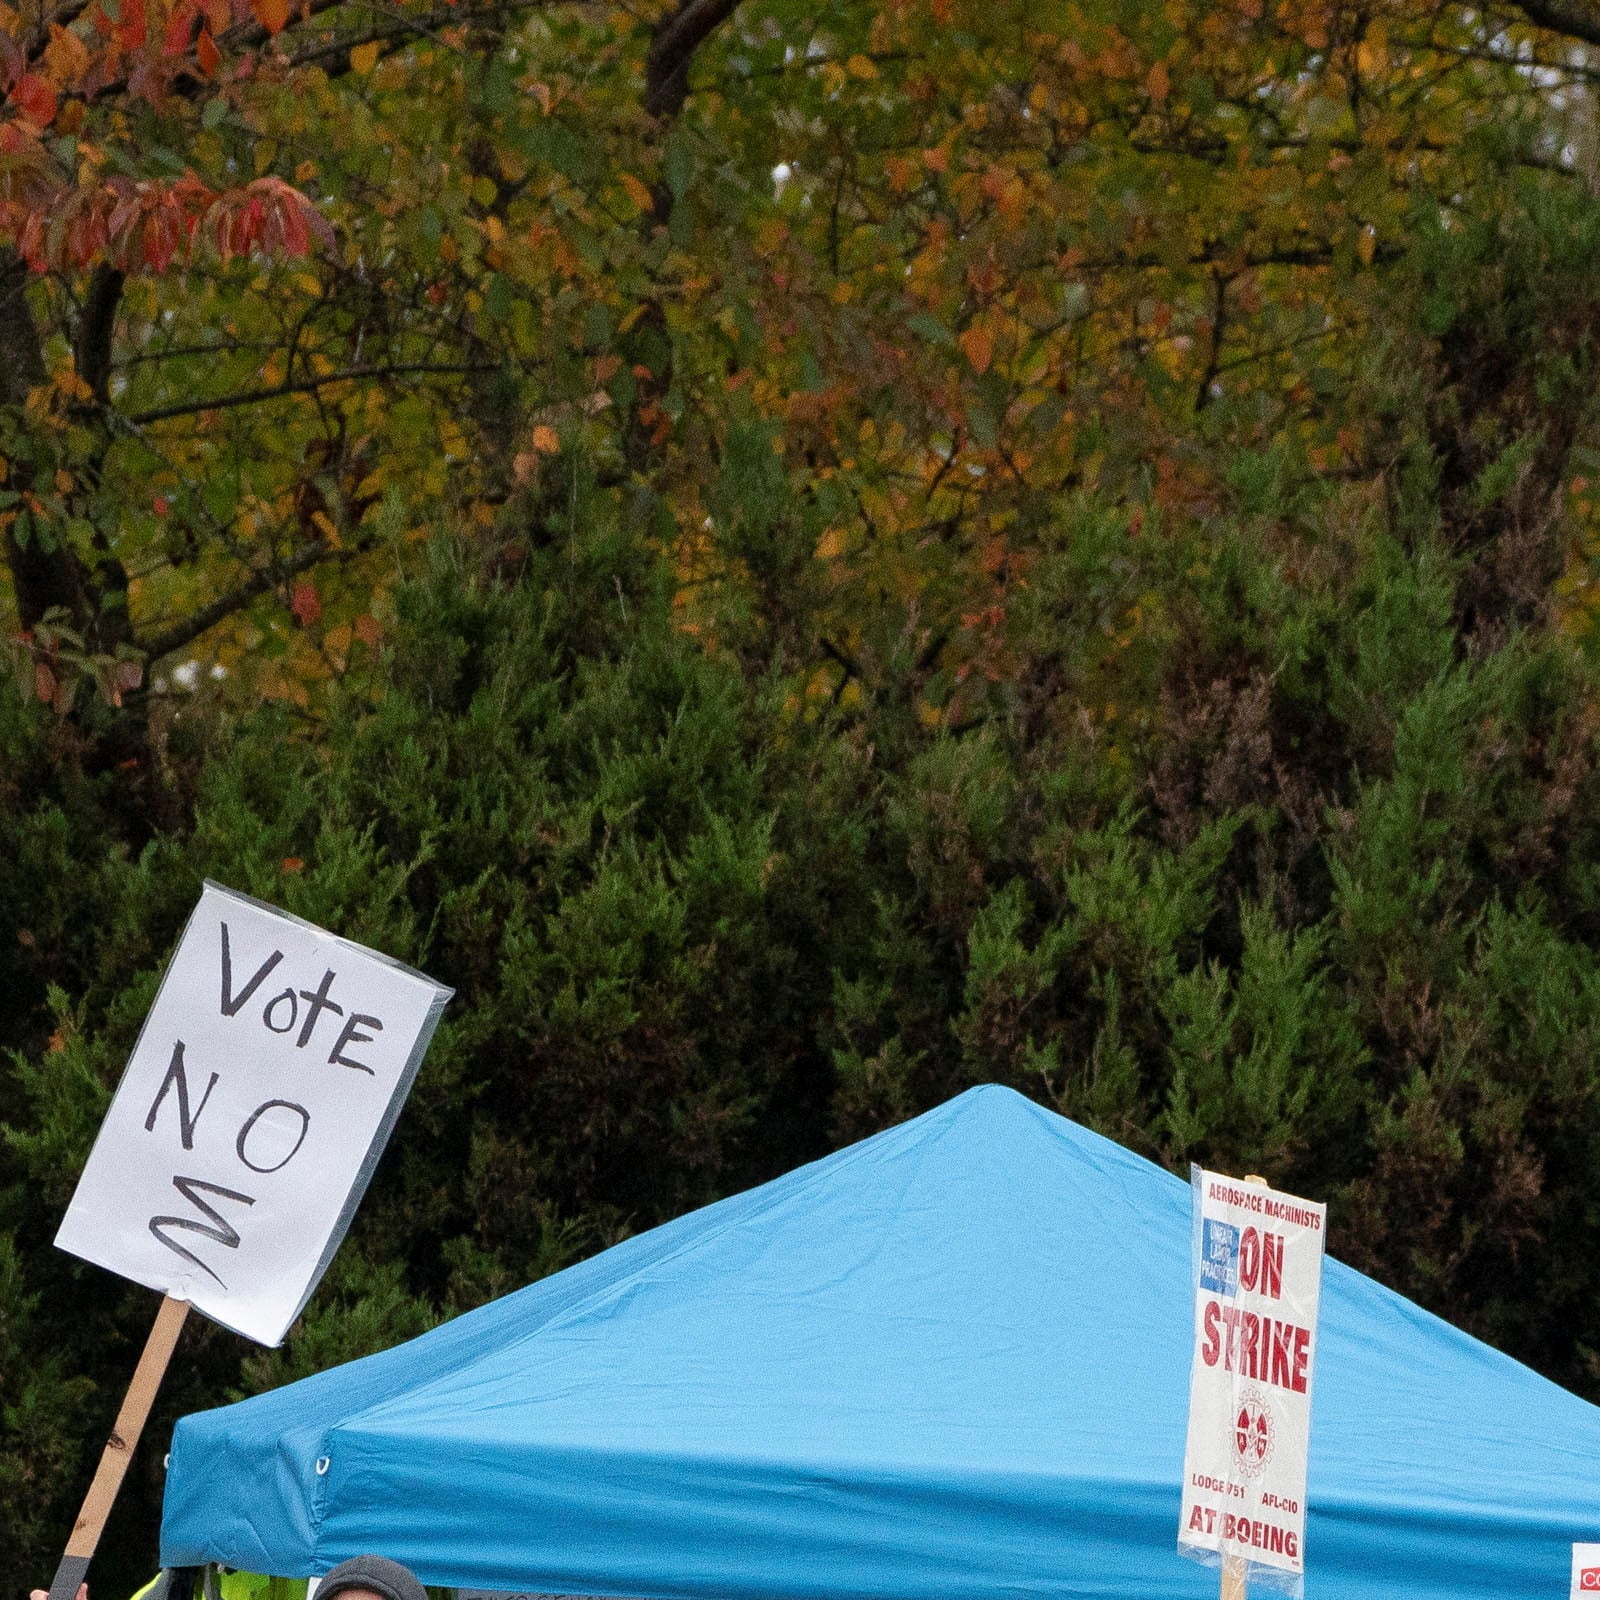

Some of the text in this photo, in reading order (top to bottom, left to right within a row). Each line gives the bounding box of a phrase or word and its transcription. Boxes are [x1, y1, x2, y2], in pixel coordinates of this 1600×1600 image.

[144, 1039, 311, 1174] NO
[1208, 1181, 1321, 1230] AEROSPACE MACHINISTS
[1239, 1225, 1285, 1300] ON
[1201, 1300, 1311, 1394] STRIKE
[1192, 1473, 1225, 1494] LODGE
[1262, 1492, 1298, 1514] AFL-CIO
[1188, 1505, 1298, 1558] AT BOEING
